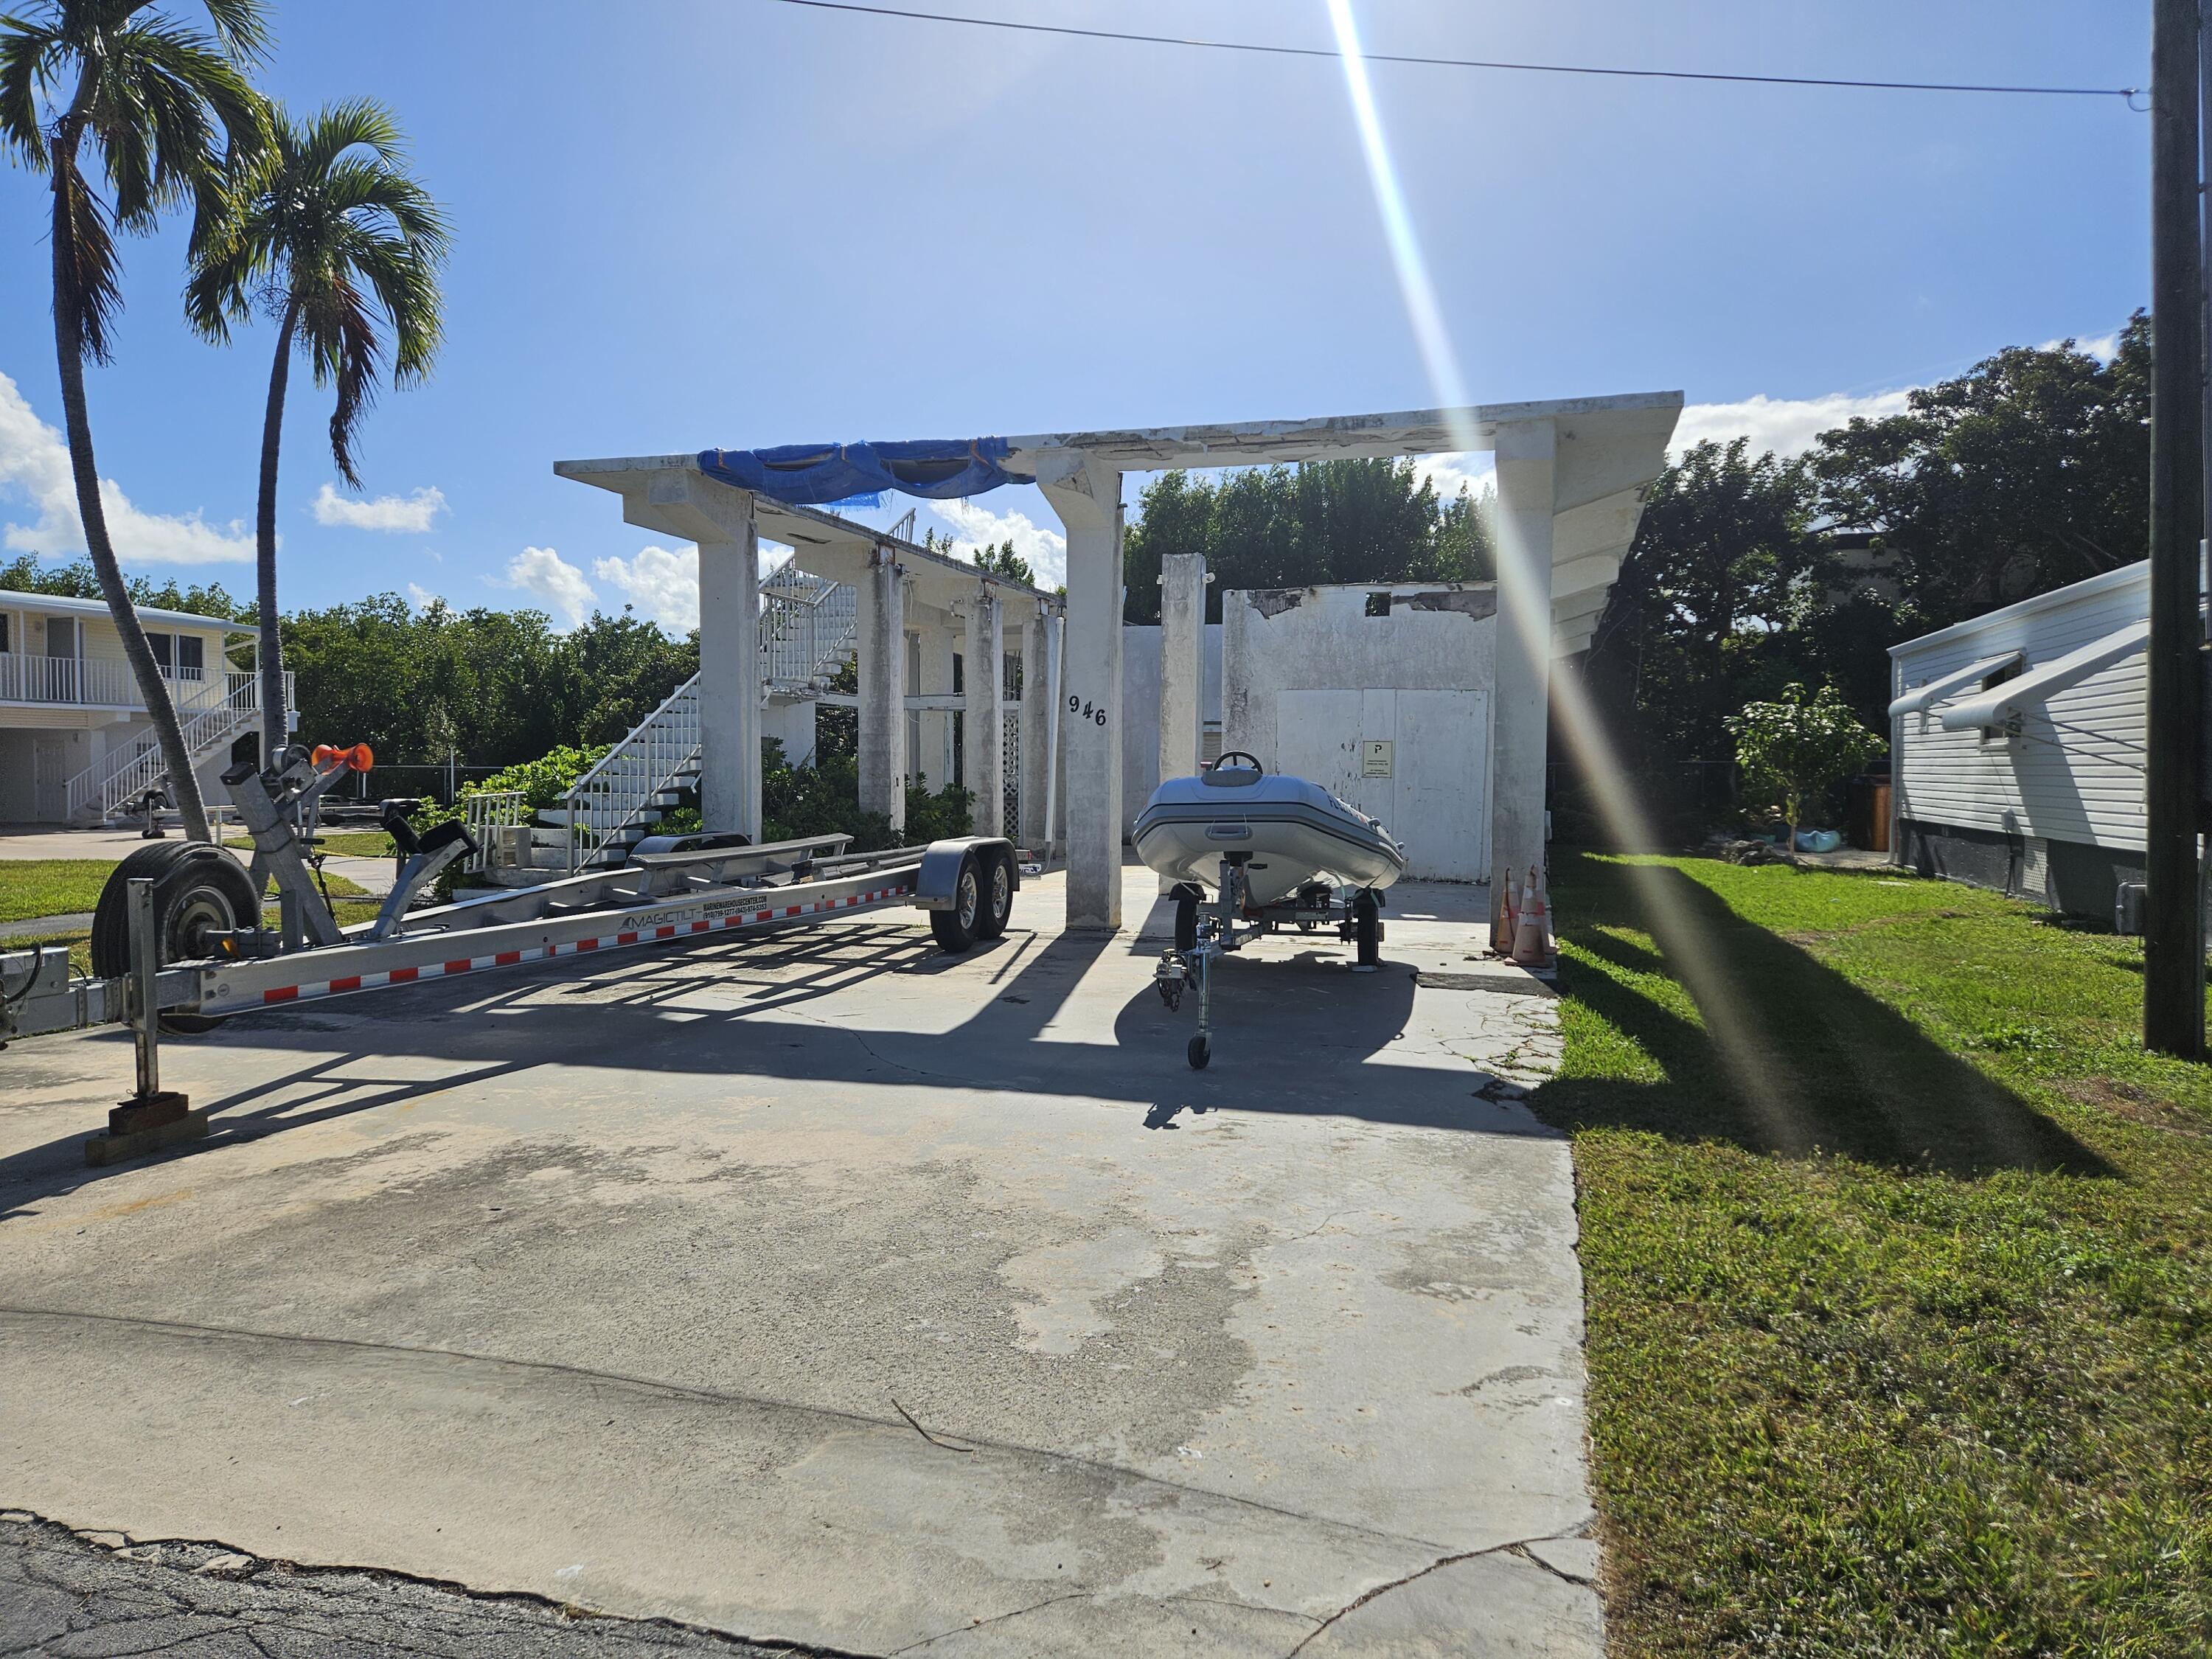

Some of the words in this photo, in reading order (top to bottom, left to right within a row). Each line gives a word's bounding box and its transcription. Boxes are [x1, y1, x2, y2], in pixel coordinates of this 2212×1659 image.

[1069, 695, 1106, 726] 946
[1374, 745, 1382, 754] P
[703, 895, 768, 911] MARINEWAREHOUSECENTER.COM
[632, 908, 697, 928] MAGICTILT
